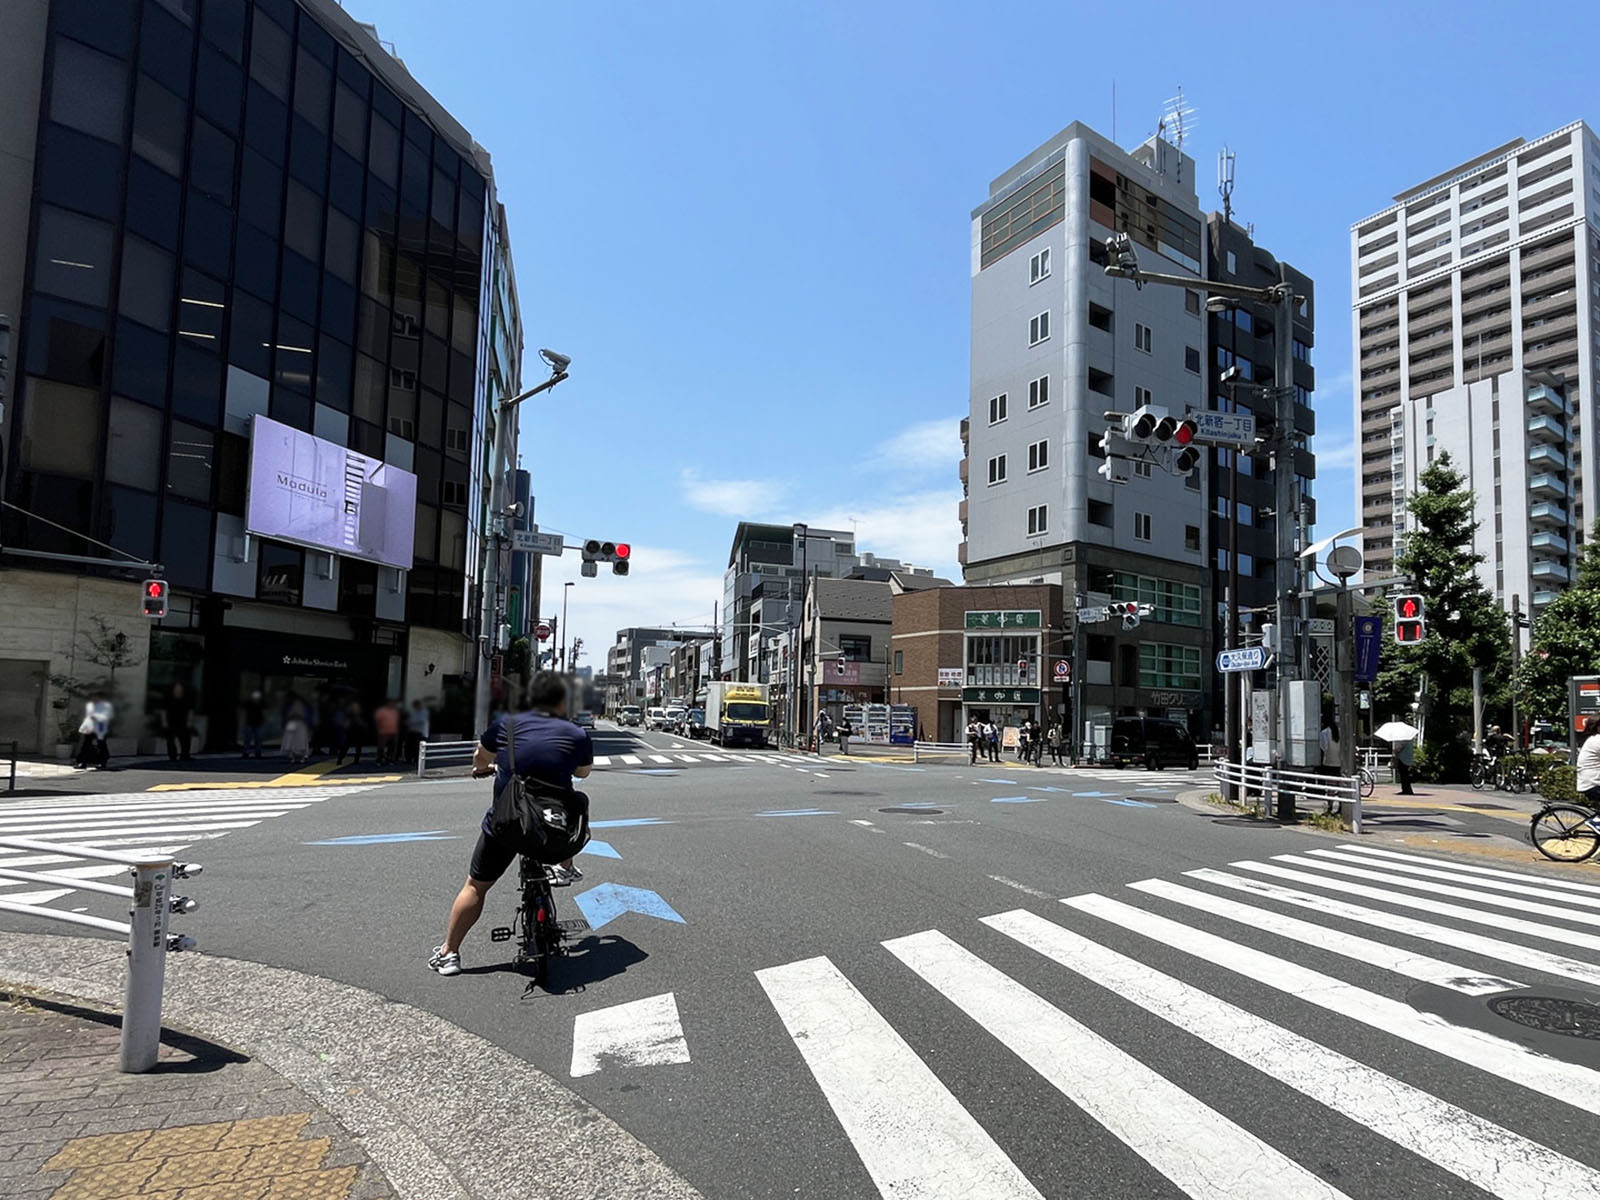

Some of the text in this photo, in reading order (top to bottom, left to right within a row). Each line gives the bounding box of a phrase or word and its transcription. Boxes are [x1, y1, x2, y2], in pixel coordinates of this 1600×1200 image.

[1195, 414, 1252, 432] 北新宿一丁目
[1201, 428, 1241, 439] Kitashinjuku
[1231, 650, 1259, 661] 大久保通り
